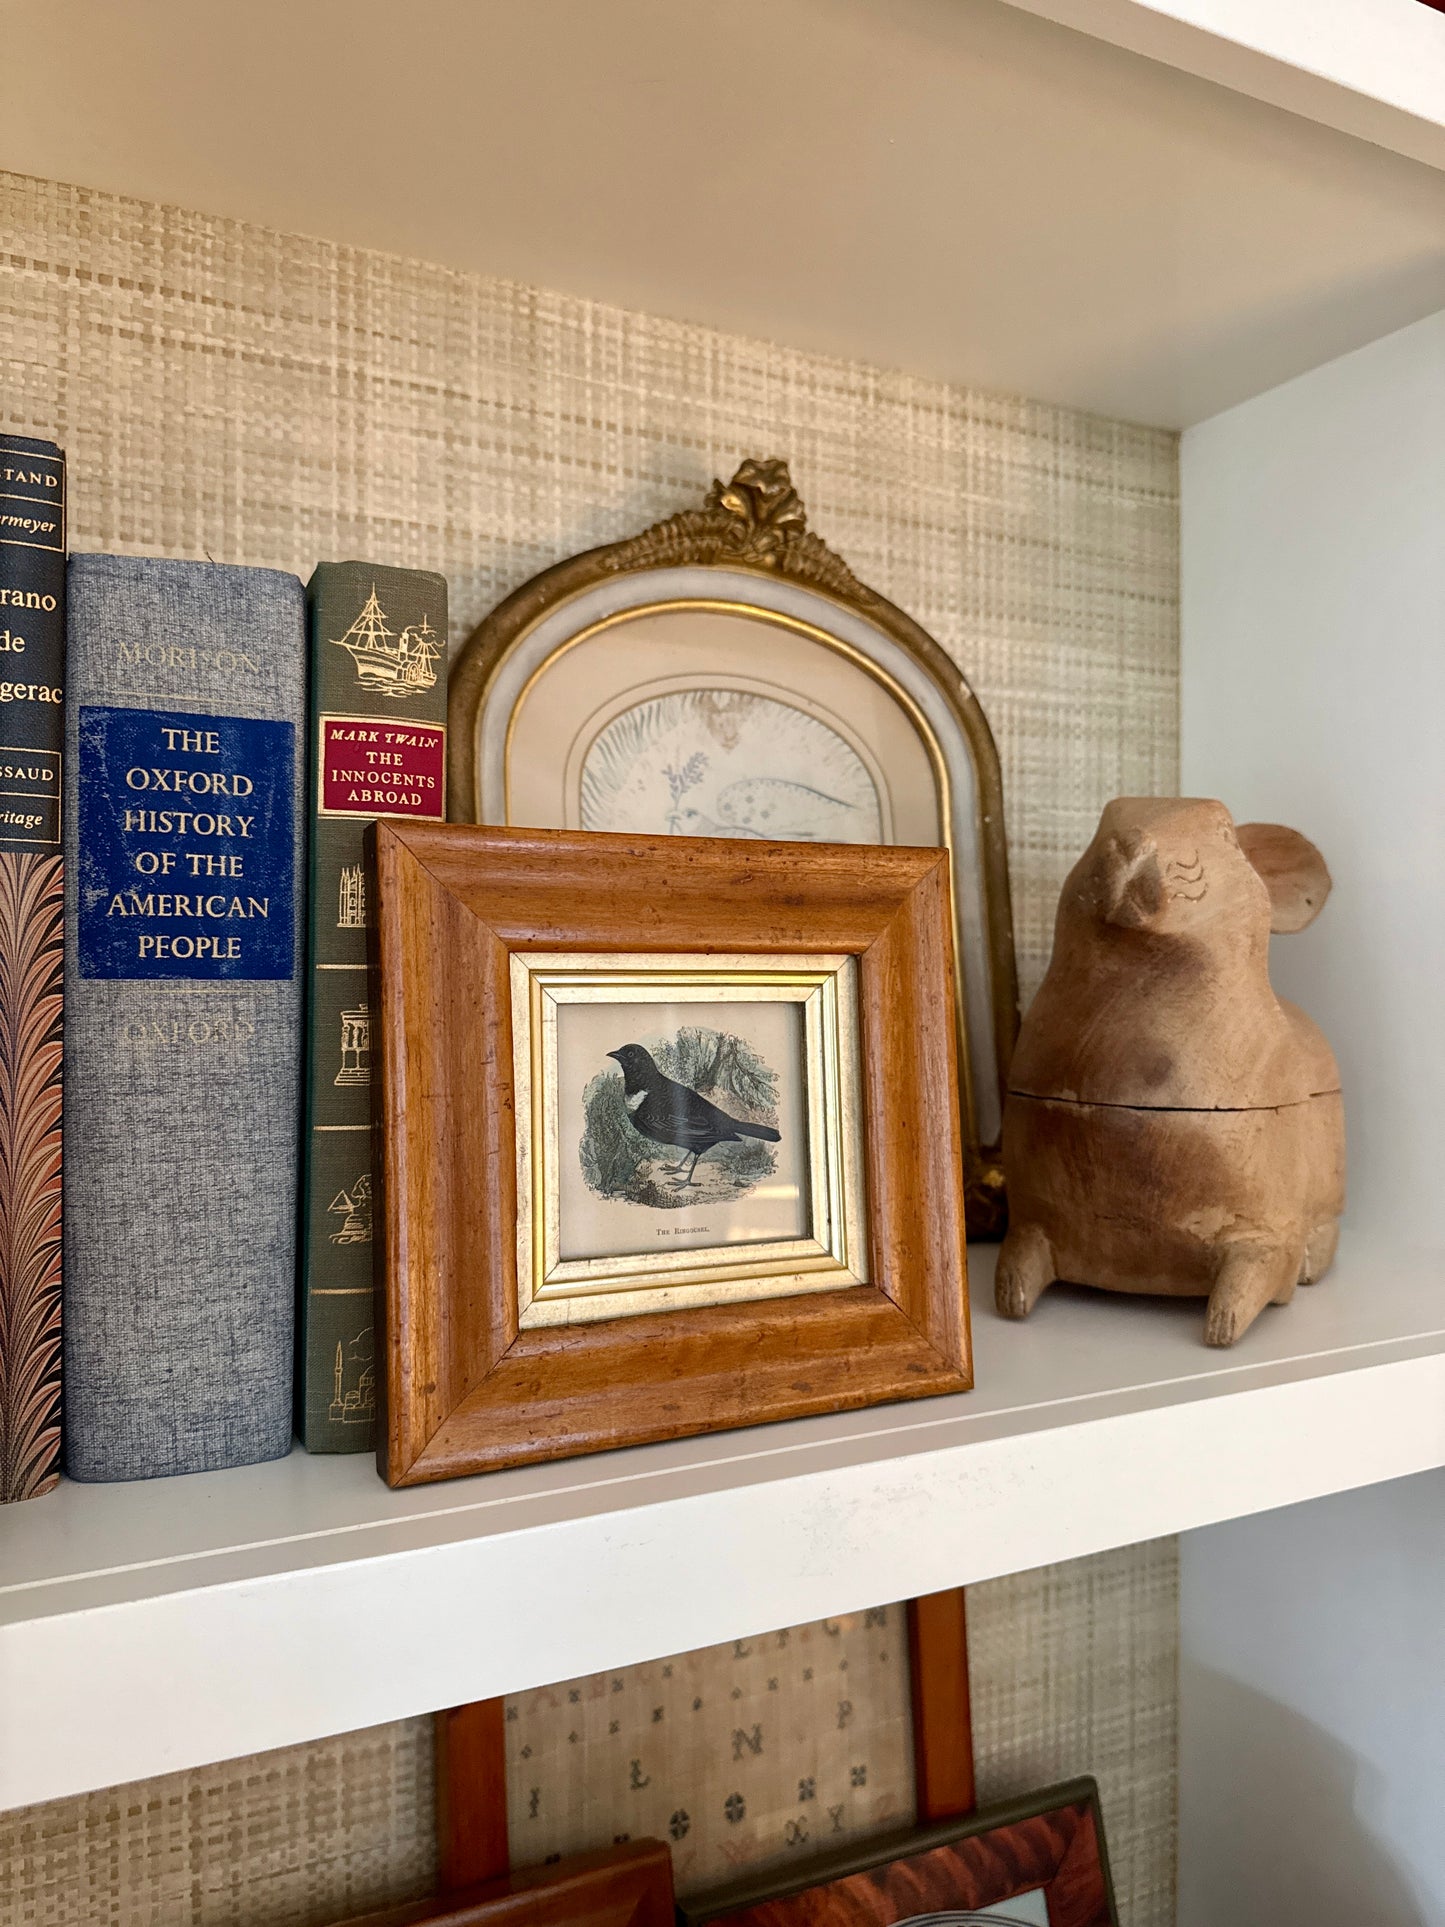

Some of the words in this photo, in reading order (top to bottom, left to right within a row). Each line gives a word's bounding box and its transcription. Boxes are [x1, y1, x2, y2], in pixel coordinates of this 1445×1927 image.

[0, 468, 58, 487] TAND
[0, 515, 56, 534] rmeyer
[161, 727, 220, 754] THE
[330, 728, 380, 743] MARK
[384, 732, 439, 749] TWAIN
[365, 751, 403, 766] THE
[126, 768, 254, 797] OXFORD
[331, 769, 435, 789] INNOCENTS
[347, 789, 422, 806] ABROAD
[123, 809, 255, 837] HISTORY
[135, 851, 176, 876] OF
[186, 853, 244, 878] THE
[107, 893, 270, 919] AMERICAN
[138, 935, 242, 960] PEOPLE
